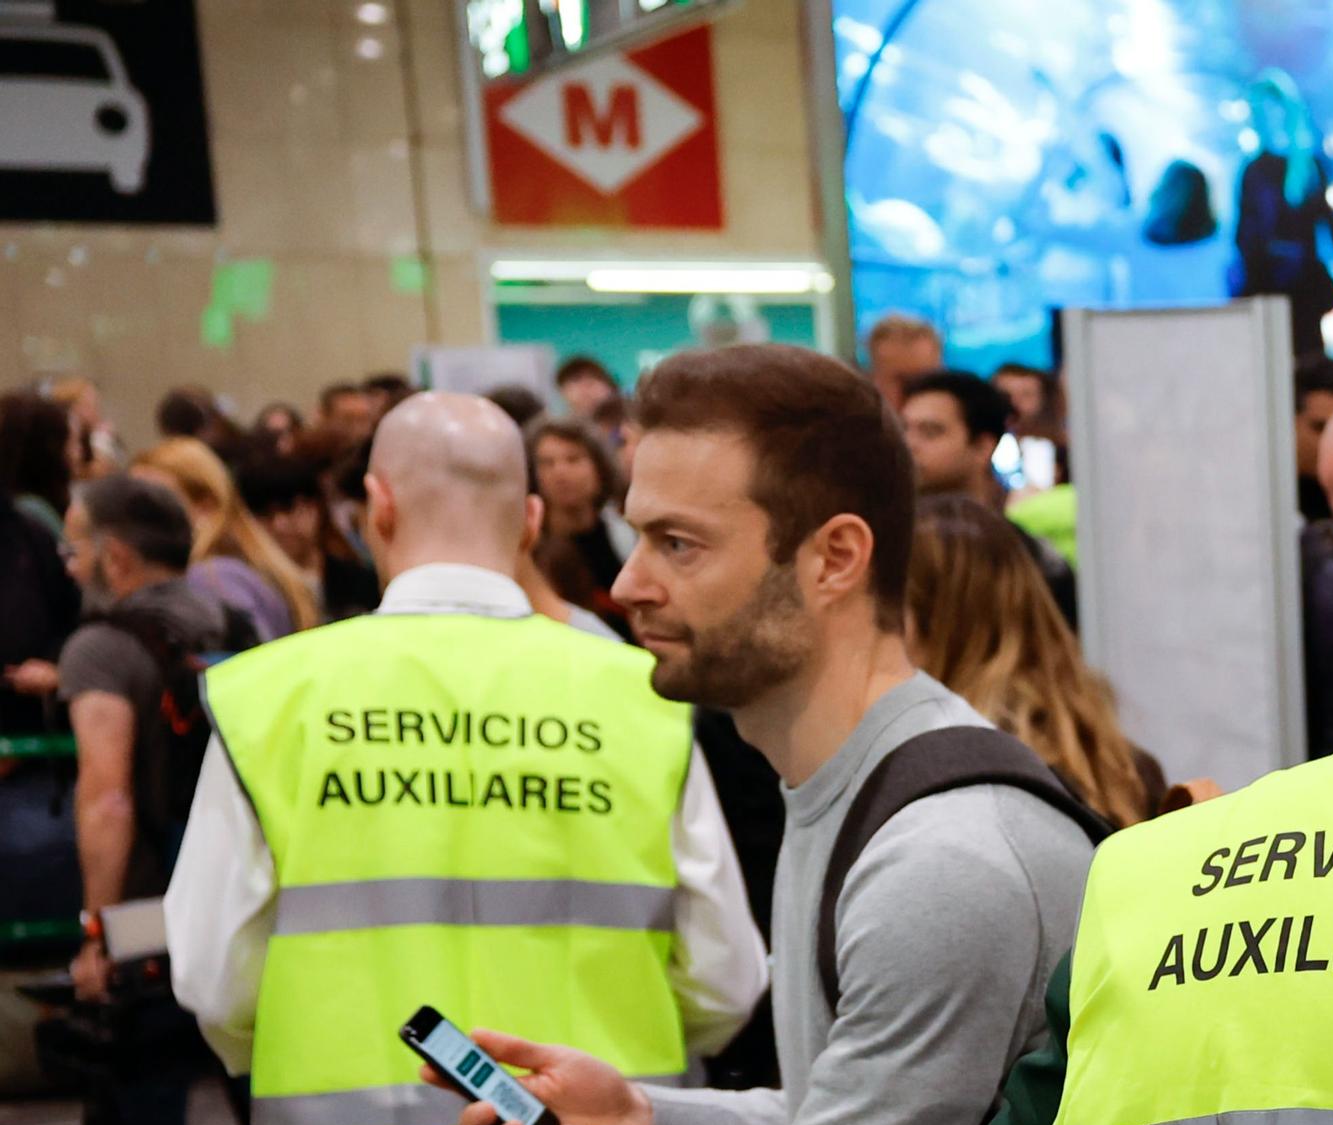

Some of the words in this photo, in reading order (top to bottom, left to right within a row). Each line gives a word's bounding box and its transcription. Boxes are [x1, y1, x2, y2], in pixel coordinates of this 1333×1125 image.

[562, 82, 643, 150] M
[327, 710, 602, 752] SERVICIOS
[318, 770, 613, 815] AUXILIARES
